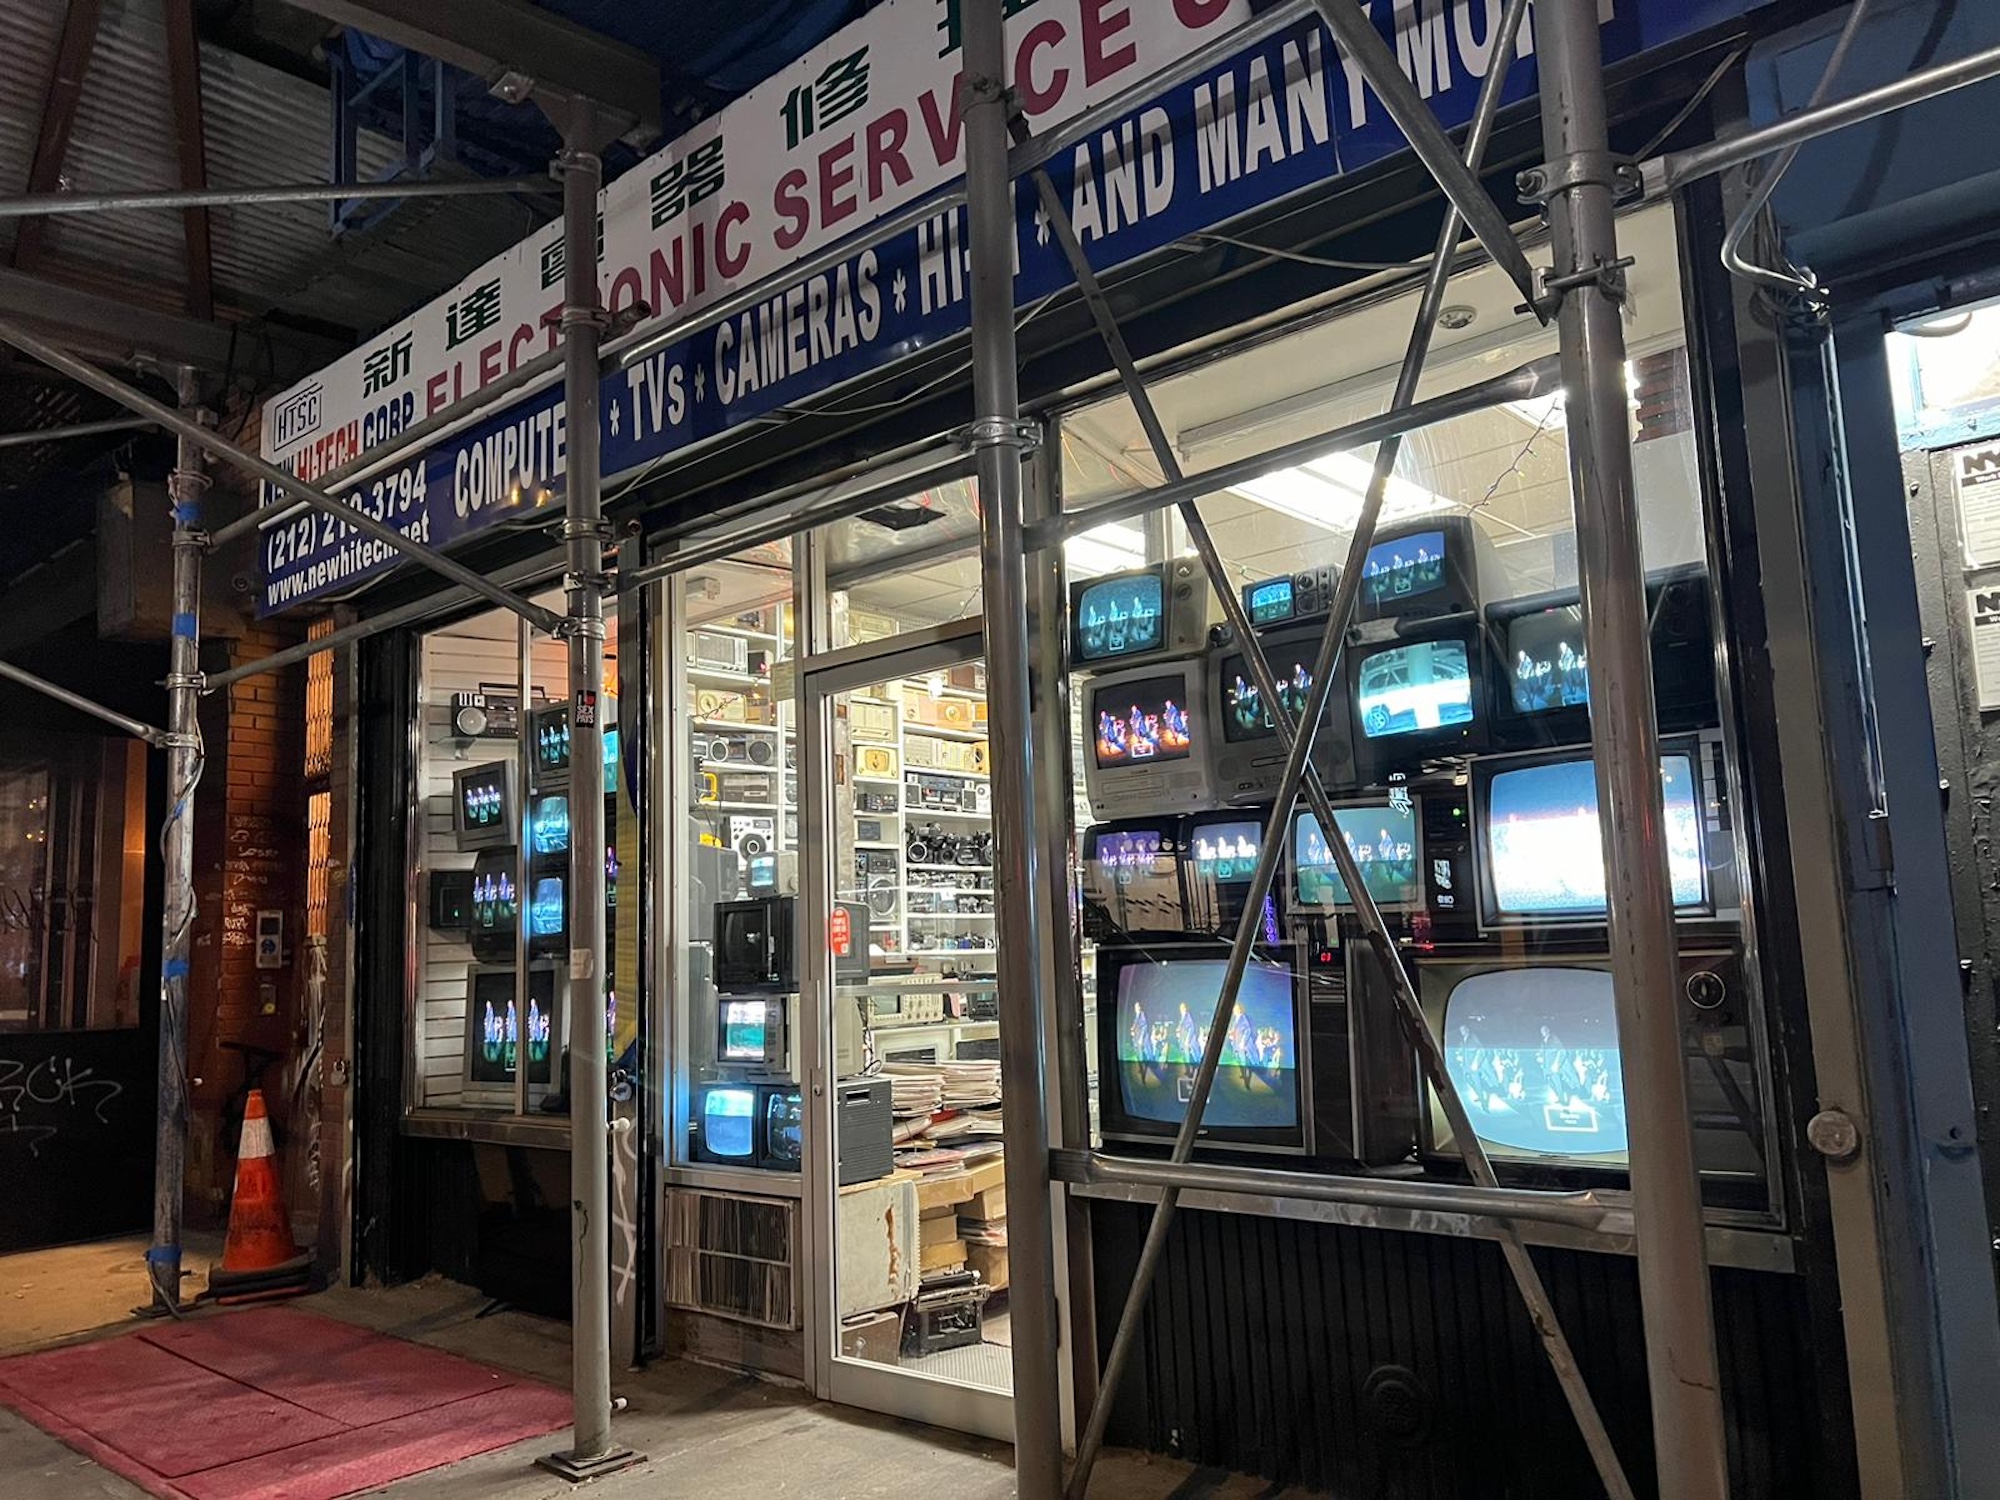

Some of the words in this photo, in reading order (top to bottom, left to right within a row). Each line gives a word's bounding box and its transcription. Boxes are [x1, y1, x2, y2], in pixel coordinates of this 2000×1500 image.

[427, 201, 752, 417] ELECTONIC
[773, 0, 1138, 249] SERVCE
[454, 401, 567, 518] COMPUTE
[627, 351, 685, 440] TVs
[714, 249, 881, 405] CAMERAS
[917, 206, 1021, 316] HI-I
[1072, 105, 1176, 248] AND
[1193, 2, 1372, 196] MANY
[278, 395, 317, 446] HTSC
[363, 390, 415, 448] CORP
[267, 512, 316, 574] (212)
